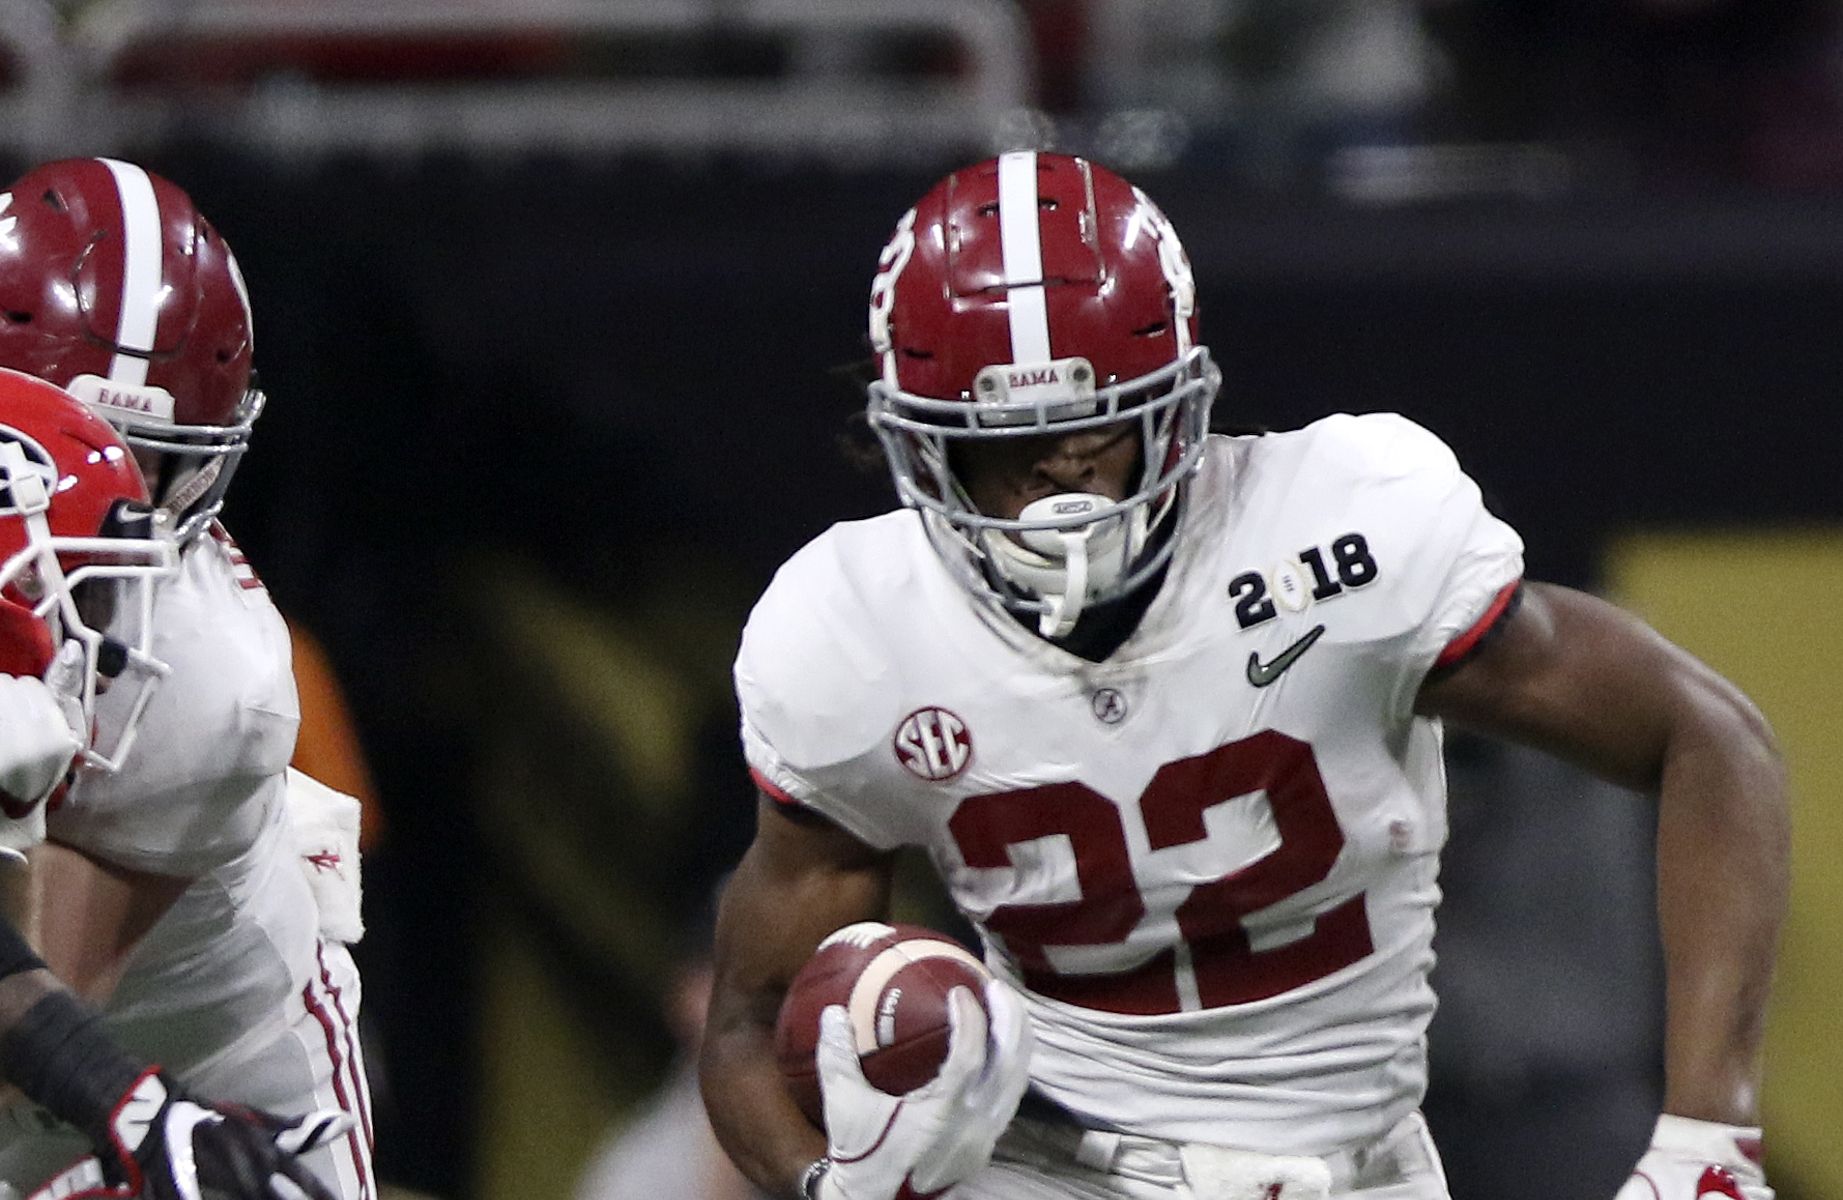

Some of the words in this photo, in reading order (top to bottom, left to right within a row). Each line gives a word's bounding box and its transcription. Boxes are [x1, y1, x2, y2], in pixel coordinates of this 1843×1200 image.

[98, 388, 151, 412] BAMA
[1009, 369, 1059, 388] BAMA
[896, 707, 971, 780] SEC
[948, 729, 1375, 1016] 22
